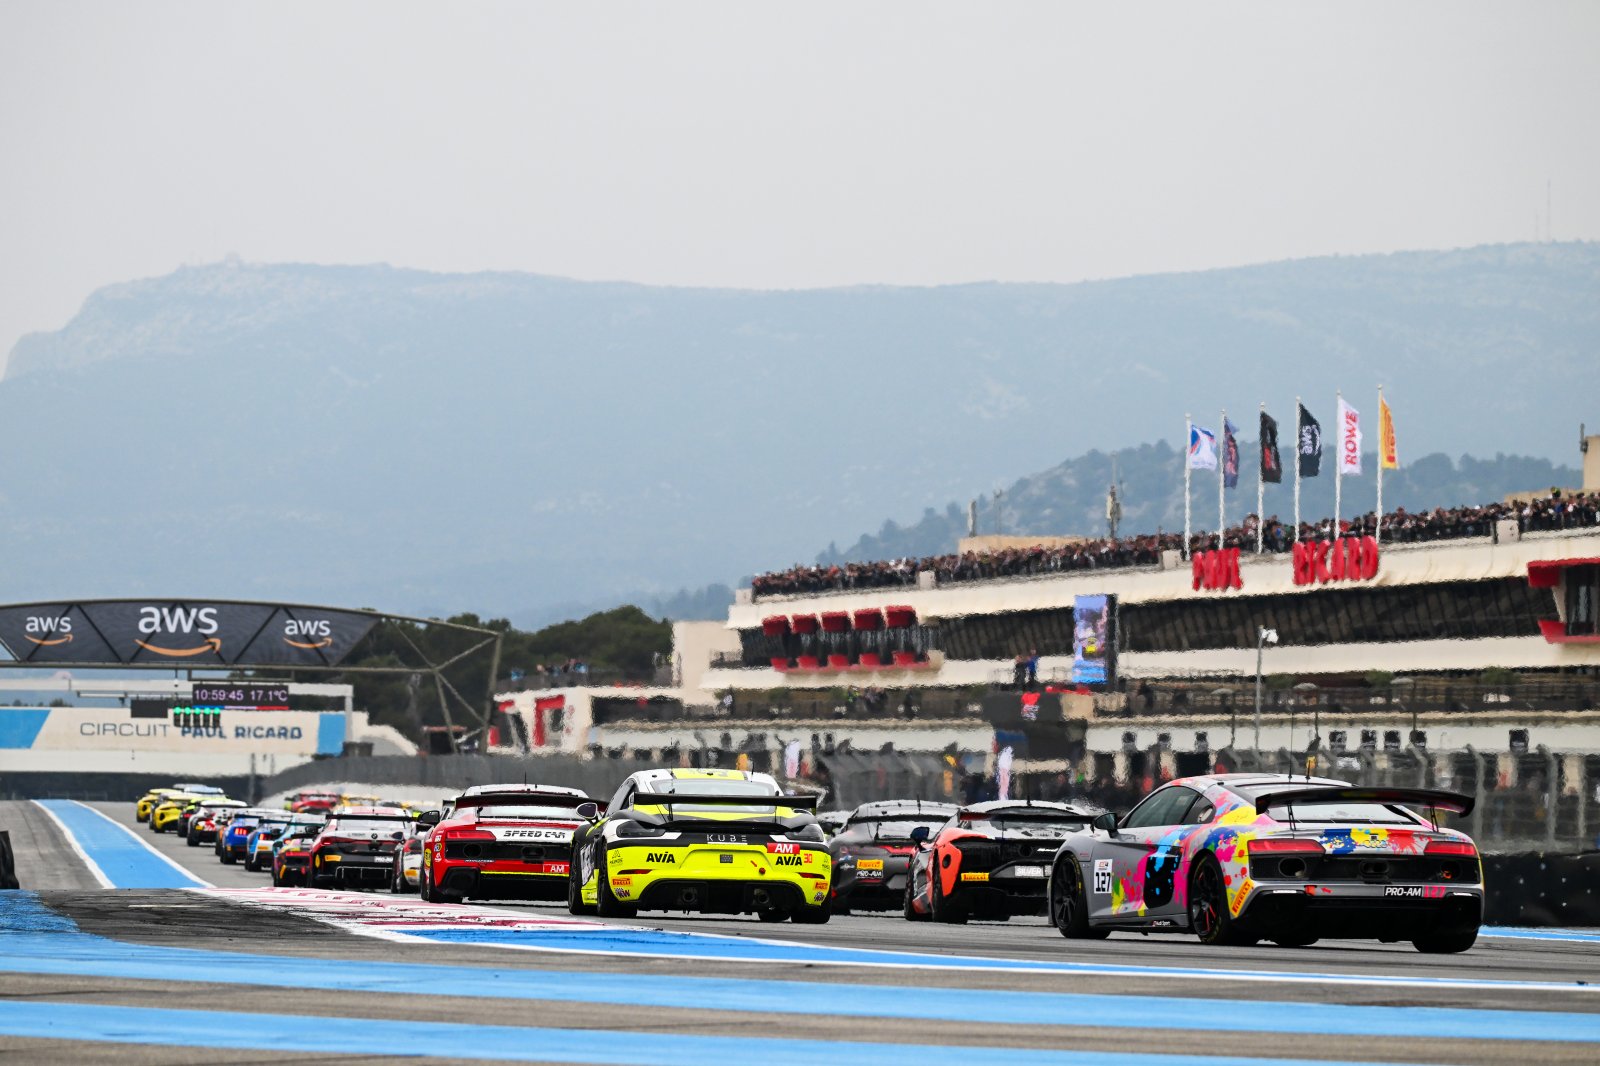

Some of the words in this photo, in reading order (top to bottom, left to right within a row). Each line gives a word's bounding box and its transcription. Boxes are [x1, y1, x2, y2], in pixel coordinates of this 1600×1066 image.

[1345, 411, 1358, 465] ROWE
[25, 616, 72, 633] aws
[138, 606, 218, 634] aws
[284, 619, 331, 636] aws
[194, 690, 244, 701] 10:59:45
[79, 722, 170, 737] CIRCUIT
[181, 726, 226, 739] PAUL
[234, 726, 303, 740] RICARD
[503, 830, 542, 838] SPEED
[706, 834, 748, 842] KUBE
[774, 843, 793, 854] AM
[646, 852, 676, 864] AVIA
[775, 853, 803, 866] AVIA
[804, 853, 813, 864] 30
[550, 864, 565, 873] AM
[1016, 867, 1043, 876] SILVER
[1095, 872, 1111, 892] 127
[1231, 880, 1251, 914] PIRELLI
[1385, 887, 1422, 897] PRO-AM
[1423, 886, 1446, 898] 127
